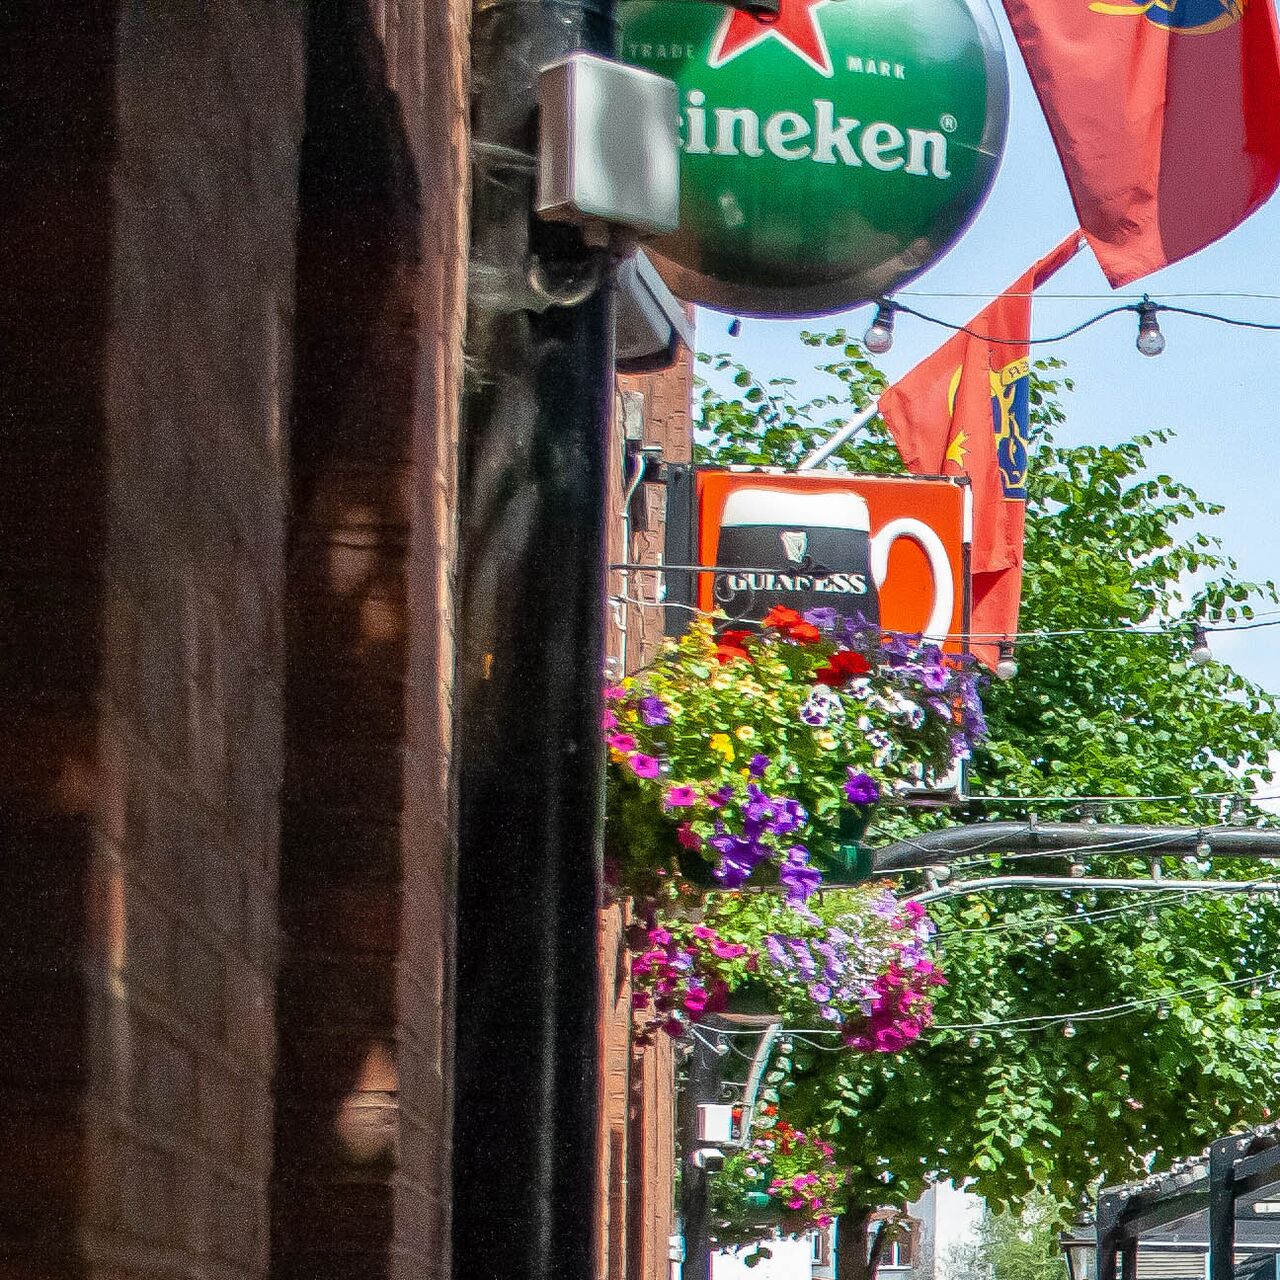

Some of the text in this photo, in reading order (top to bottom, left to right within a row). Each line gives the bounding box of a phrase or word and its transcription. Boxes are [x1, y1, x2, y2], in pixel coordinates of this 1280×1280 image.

[628, 42, 905, 80] TRADE MARK
[676, 89, 951, 179] ineken
